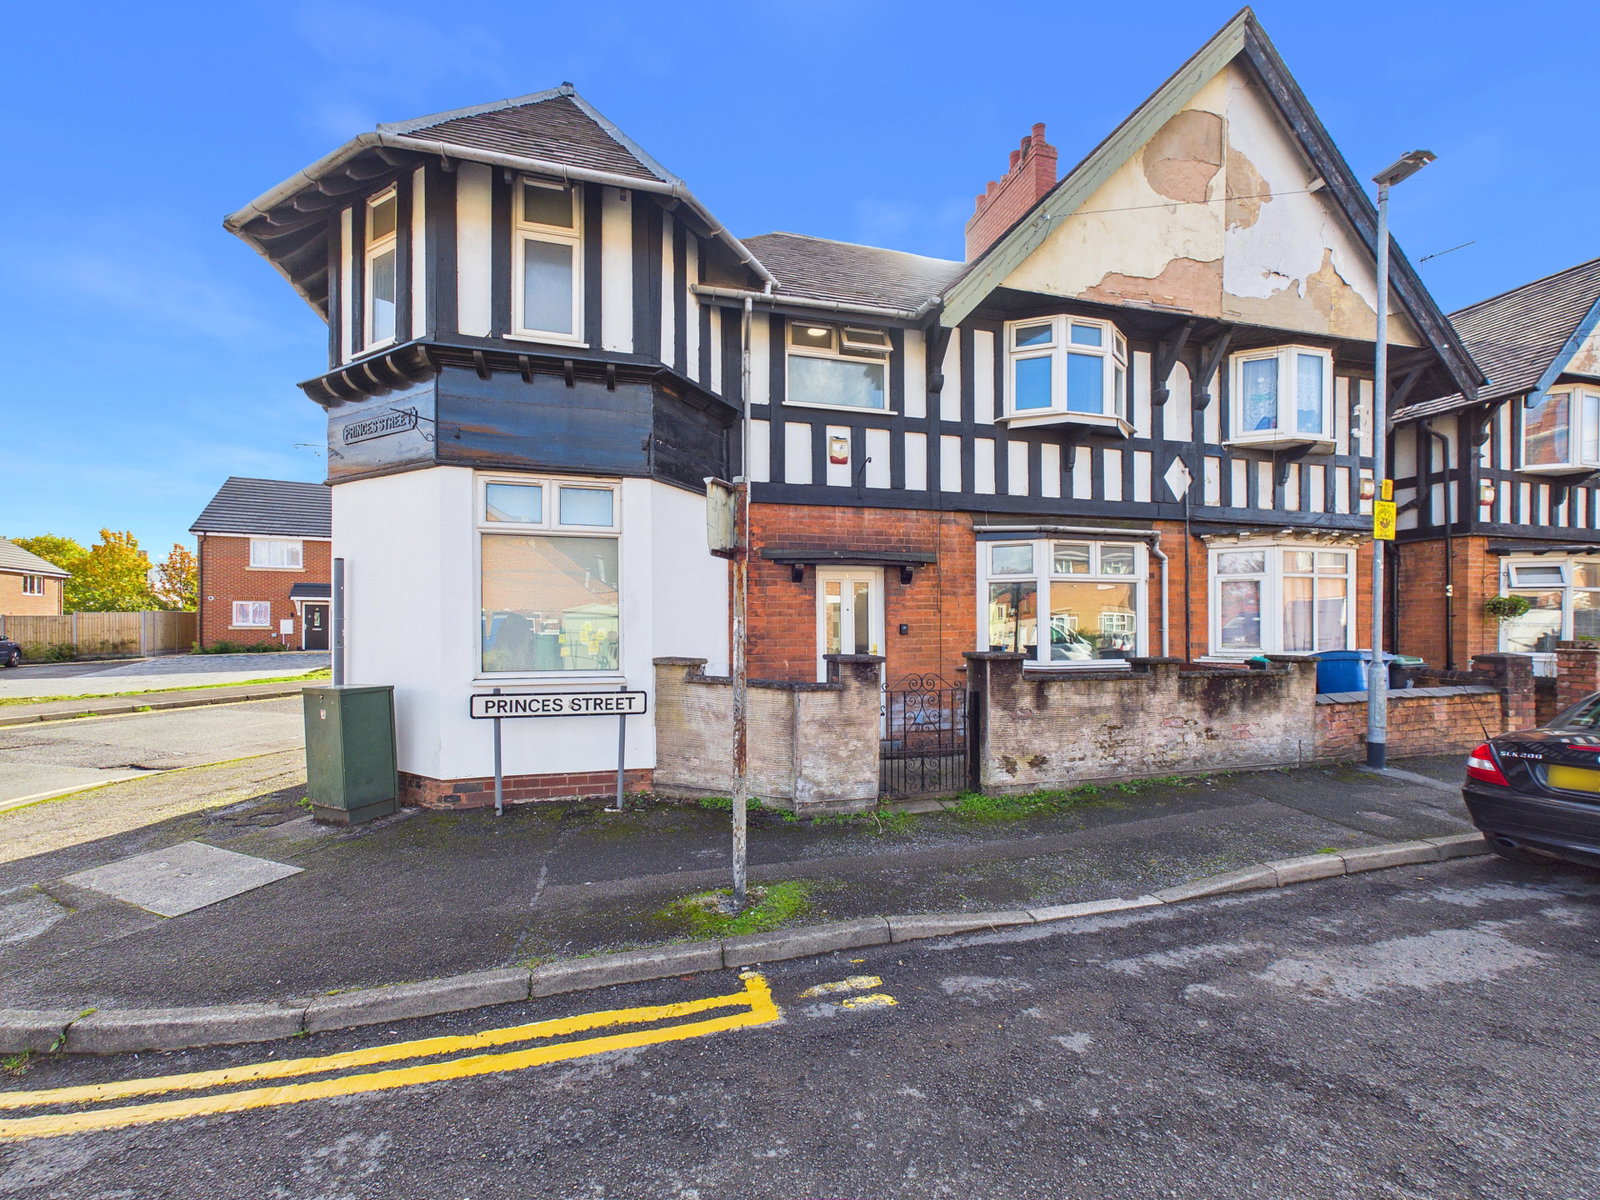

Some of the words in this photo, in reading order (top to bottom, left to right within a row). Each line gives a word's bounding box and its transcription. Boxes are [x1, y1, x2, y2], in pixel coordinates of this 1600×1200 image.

[345, 421, 378, 440] PRINCES
[380, 413, 413, 431] STREET
[484, 698, 563, 714] PRINCES
[570, 696, 636, 711] STREET
[1499, 750, 1518, 758] SLK
